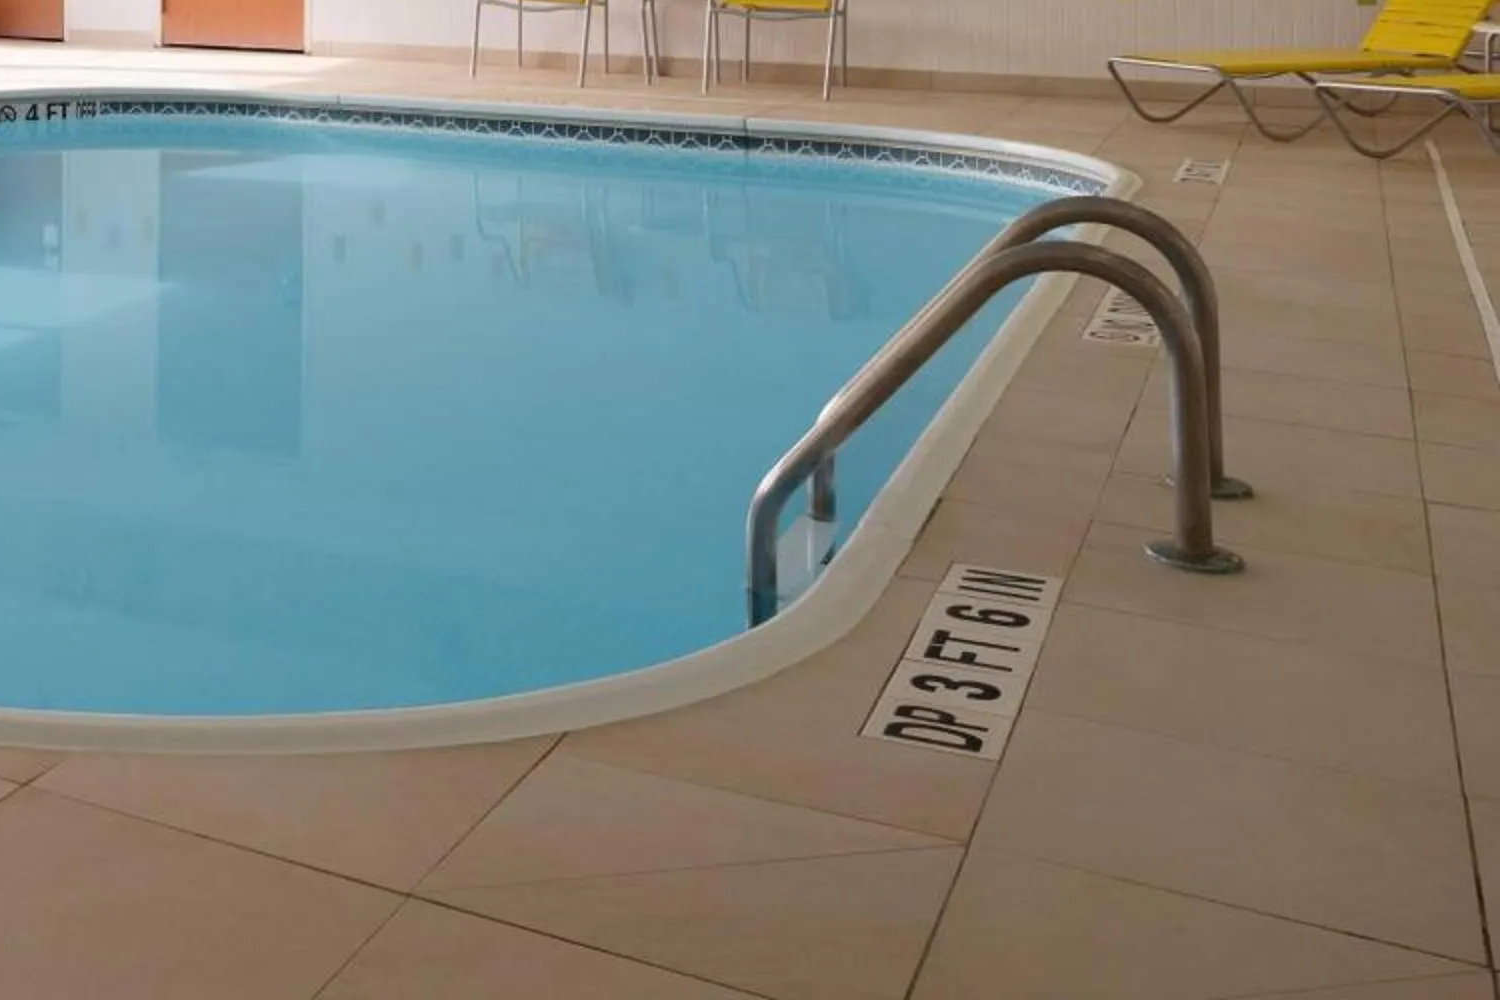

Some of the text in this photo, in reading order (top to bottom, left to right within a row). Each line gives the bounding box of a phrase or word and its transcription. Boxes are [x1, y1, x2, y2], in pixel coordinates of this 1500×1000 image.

[25, 102, 71, 121] 4 FT
[883, 568, 1047, 753] DP 3 FT 6 IN
